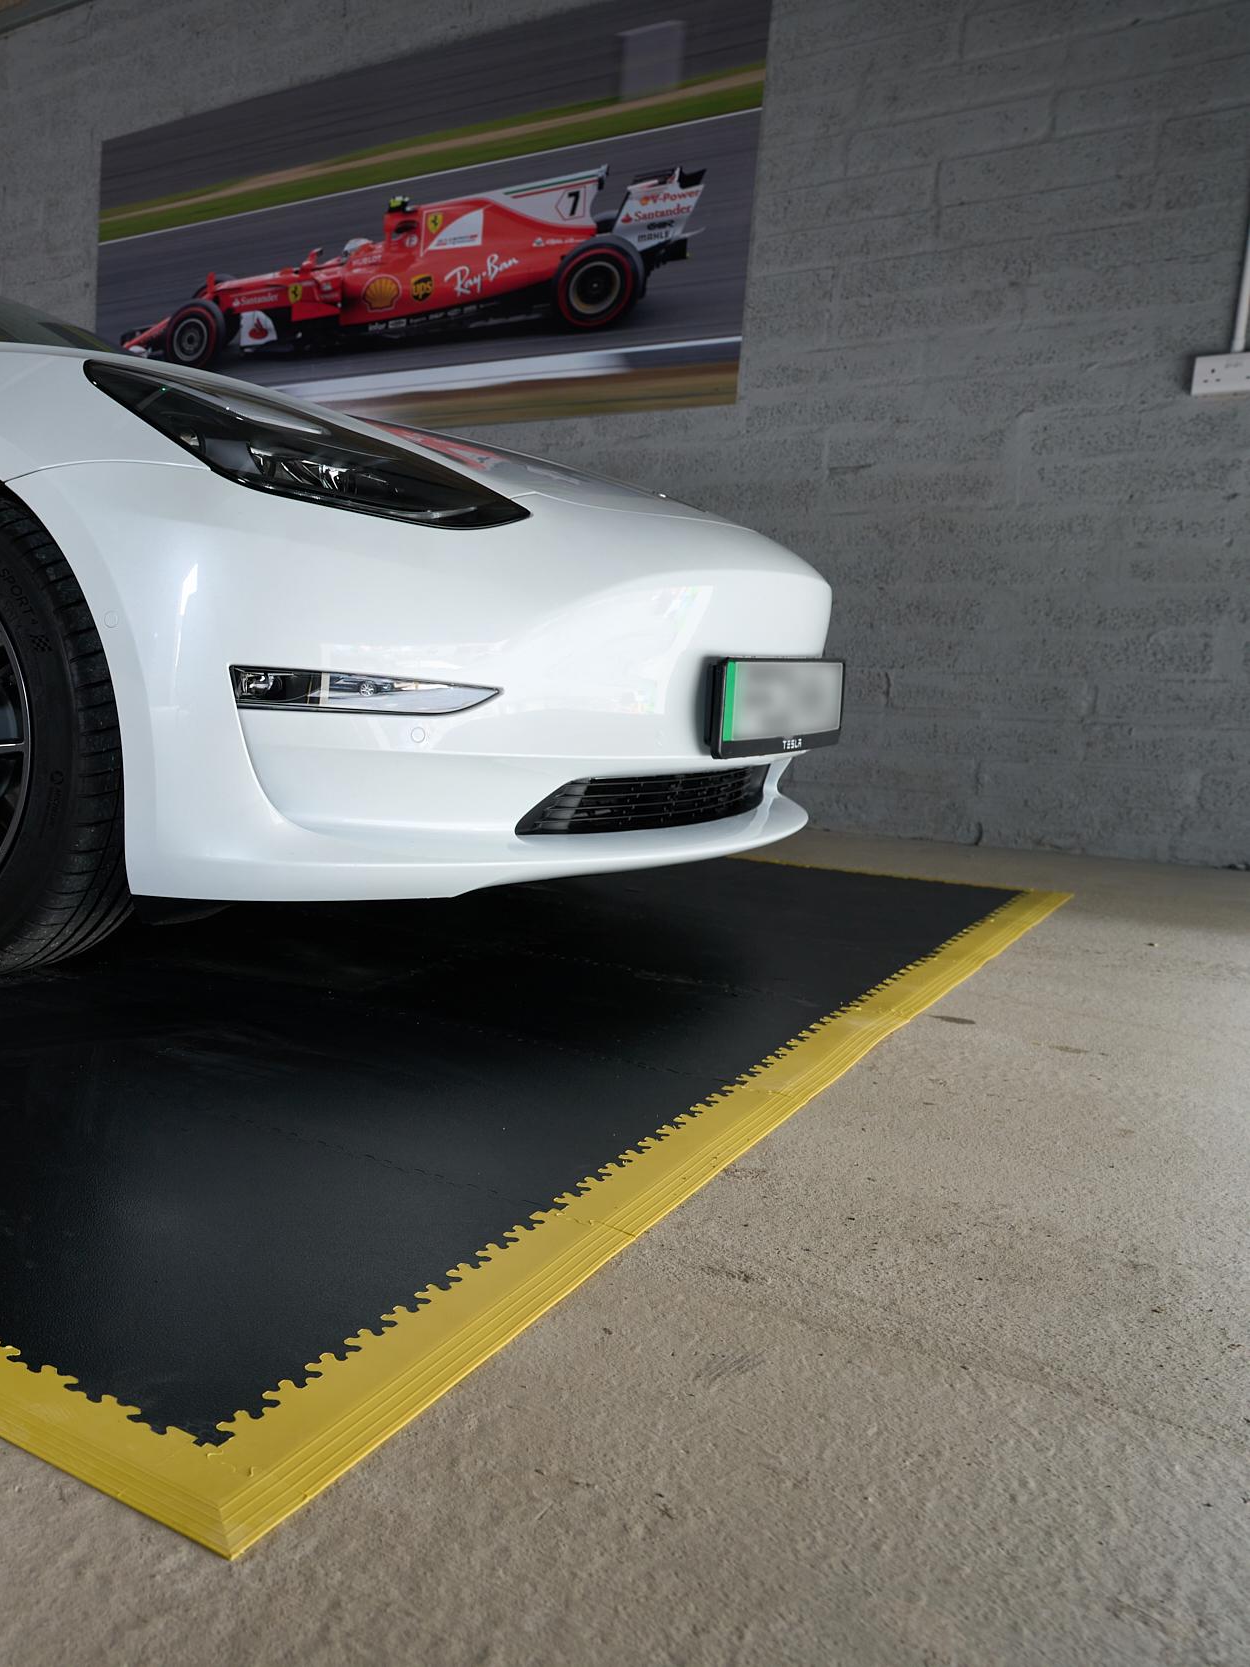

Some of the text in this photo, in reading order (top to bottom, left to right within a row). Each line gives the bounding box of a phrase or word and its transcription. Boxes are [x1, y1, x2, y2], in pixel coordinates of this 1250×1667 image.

[567, 190, 580, 216] 7
[634, 204, 692, 221] Santander
[239, 292, 279, 307] Santander
[782, 738, 802, 750] TESLA
